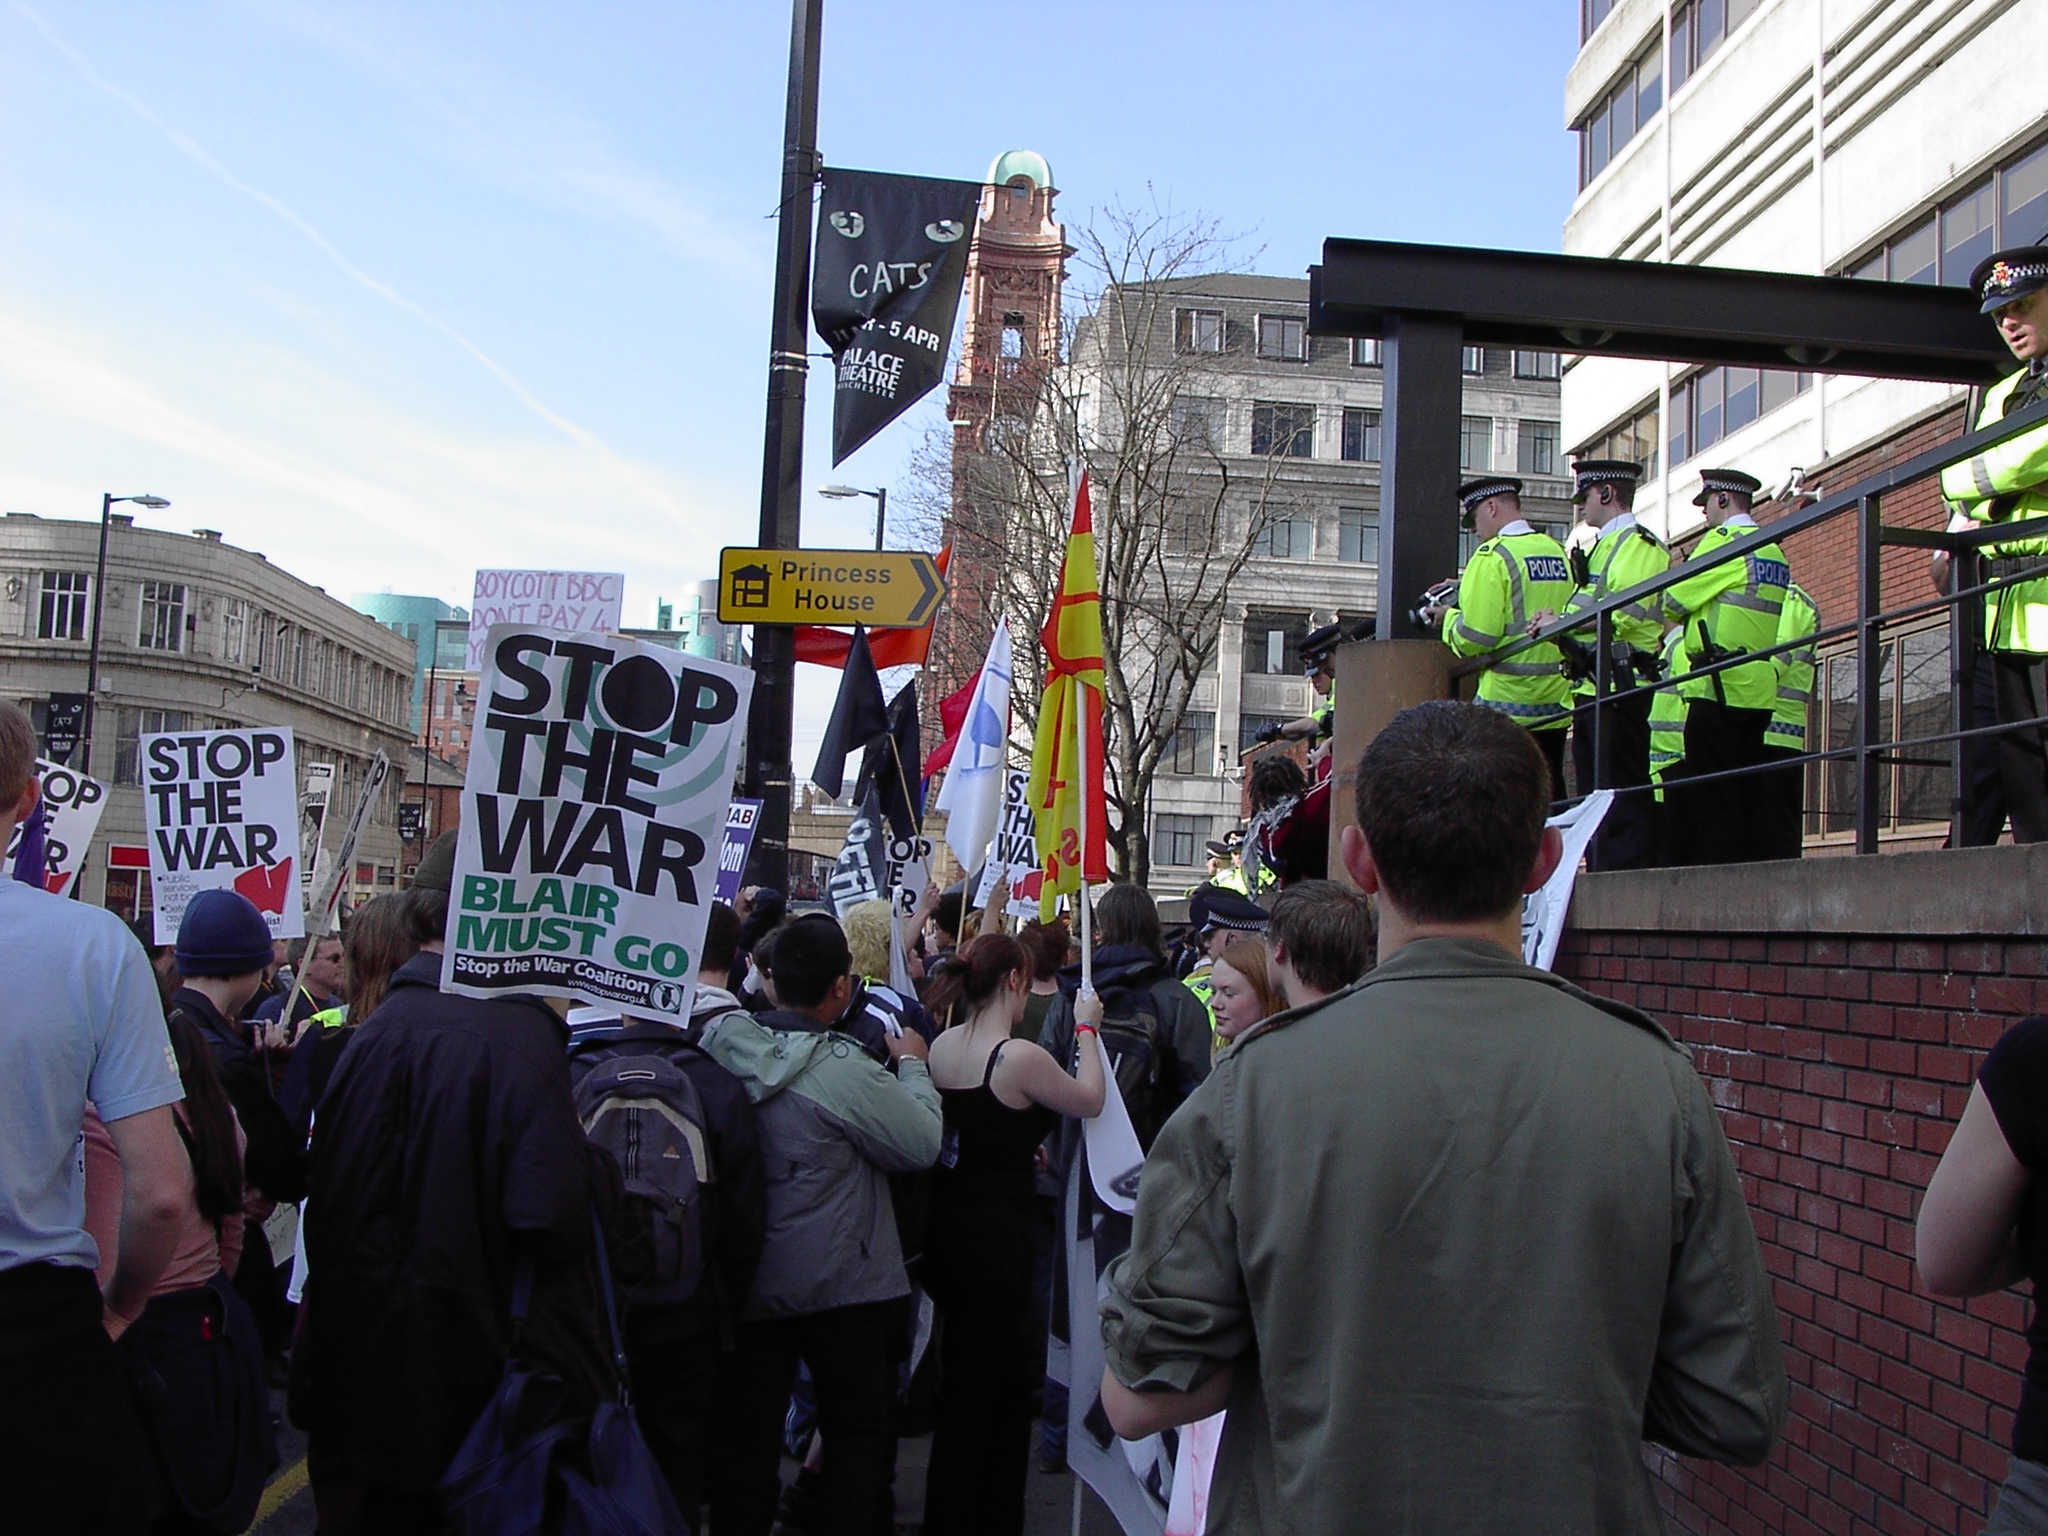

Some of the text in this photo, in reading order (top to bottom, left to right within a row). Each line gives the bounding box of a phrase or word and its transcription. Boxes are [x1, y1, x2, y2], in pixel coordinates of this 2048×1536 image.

[849, 262, 932, 298] CATS
[889, 321, 902, 337] 5
[903, 325, 940, 352] APR
[839, 365, 899, 391] THEATRE
[842, 347, 905, 376] PALACE
[474, 571, 614, 602] BOYCOTT BBC
[781, 561, 892, 584] Princess
[1528, 560, 1567, 578] POLICE
[471, 602, 612, 632] DON'T PAY 4
[795, 589, 875, 611] House
[488, 633, 739, 747] STOP
[149, 733, 285, 783] STOP
[486, 713, 667, 819] THE
[150, 780, 243, 828] THE
[155, 824, 278, 872] WAR
[476, 793, 706, 906] WAR
[461, 874, 620, 926] BLAIR
[455, 915, 689, 978] MUST GO
[455, 956, 650, 994] Stop the War Coalition
